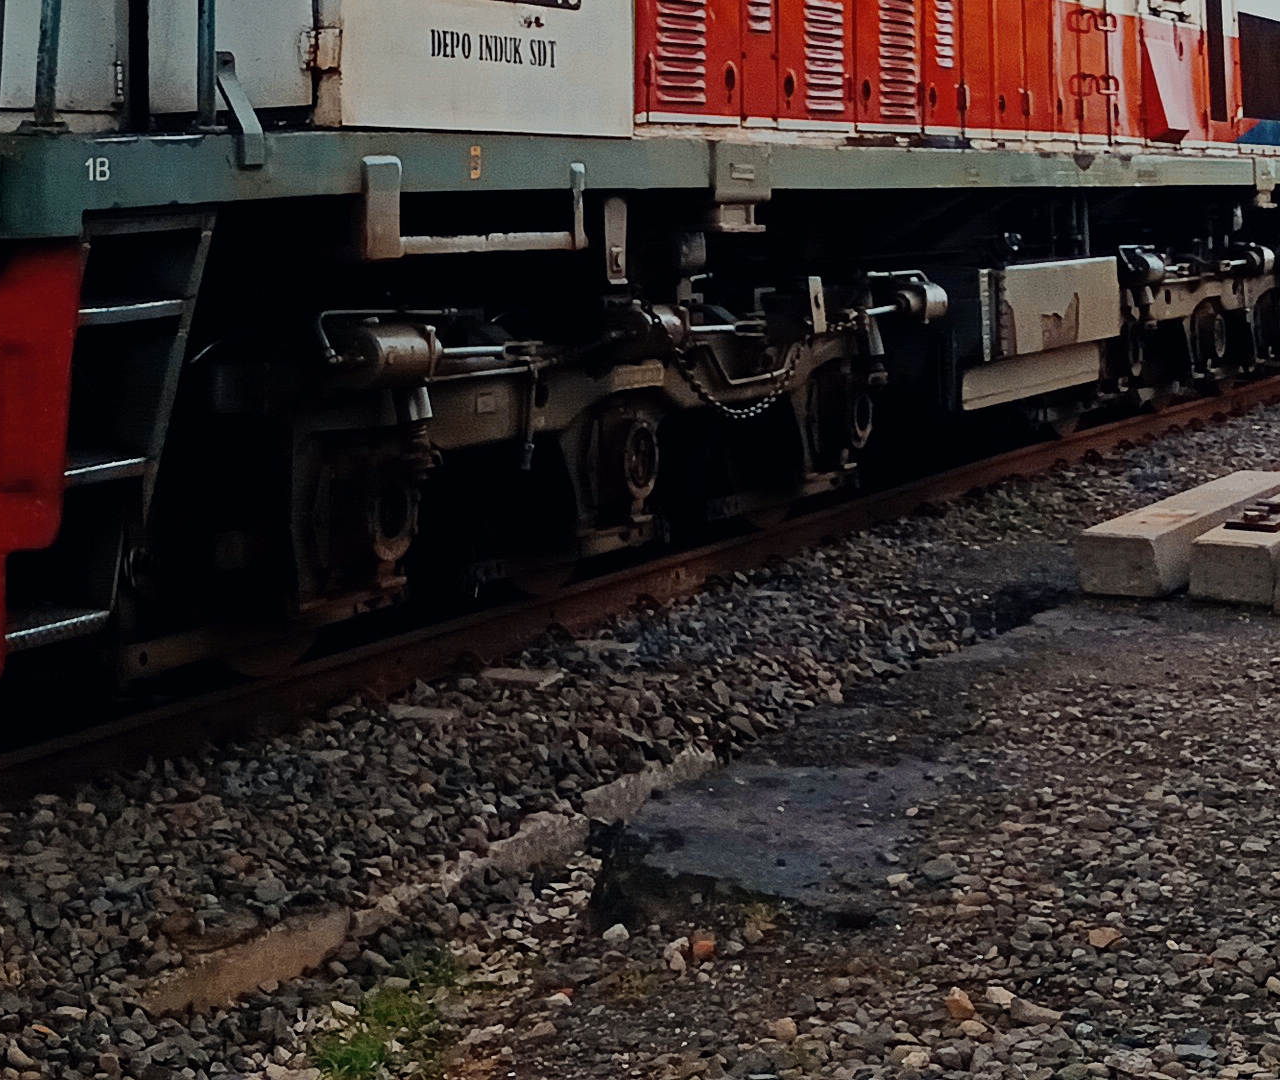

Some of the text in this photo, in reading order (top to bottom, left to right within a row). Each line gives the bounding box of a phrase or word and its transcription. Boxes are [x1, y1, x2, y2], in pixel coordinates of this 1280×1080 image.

[430, 29, 557, 68] DEPO INDUK SDT
[84, 157, 110, 181] 1B
